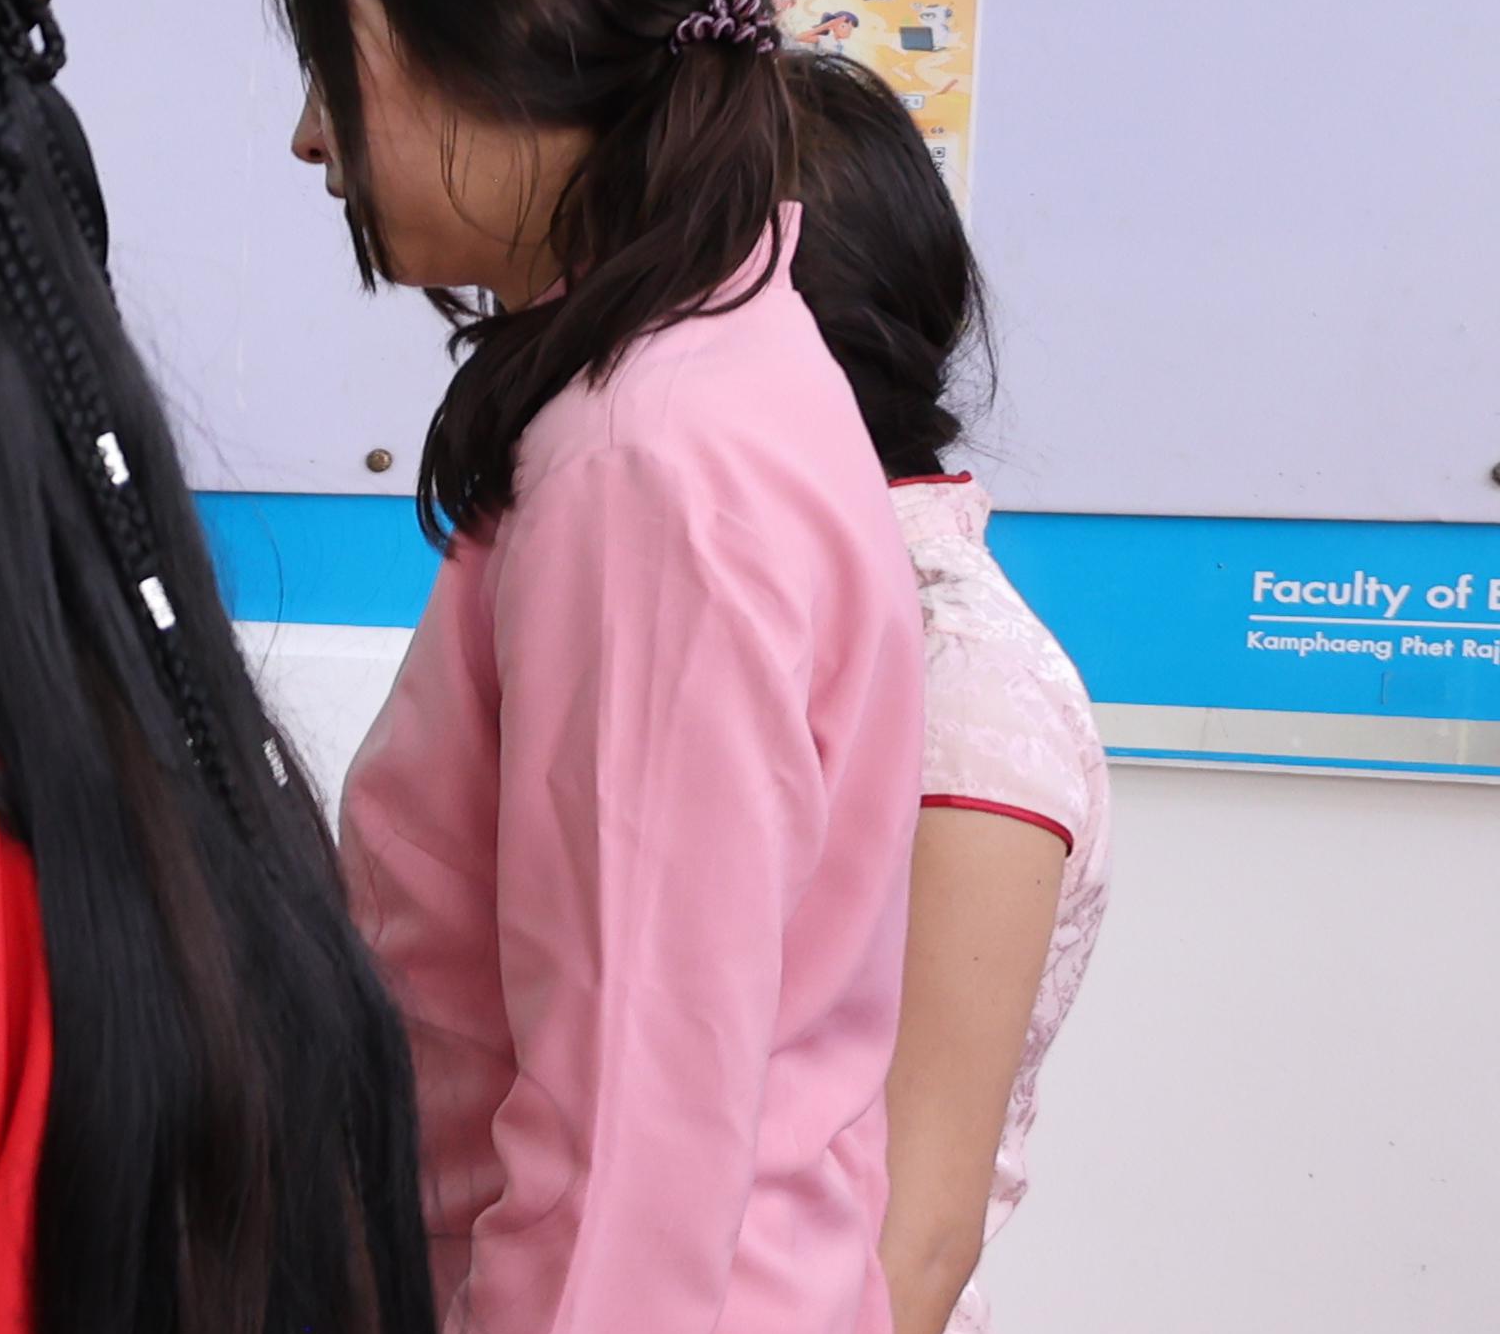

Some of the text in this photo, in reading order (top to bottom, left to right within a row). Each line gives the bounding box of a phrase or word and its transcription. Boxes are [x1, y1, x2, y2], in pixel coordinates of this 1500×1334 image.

[1252, 570, 1411, 618] Faculty
[1426, 574, 1474, 609] of
[1246, 631, 1393, 661] Kamphaeng
[1401, 635, 1455, 657] Phet
